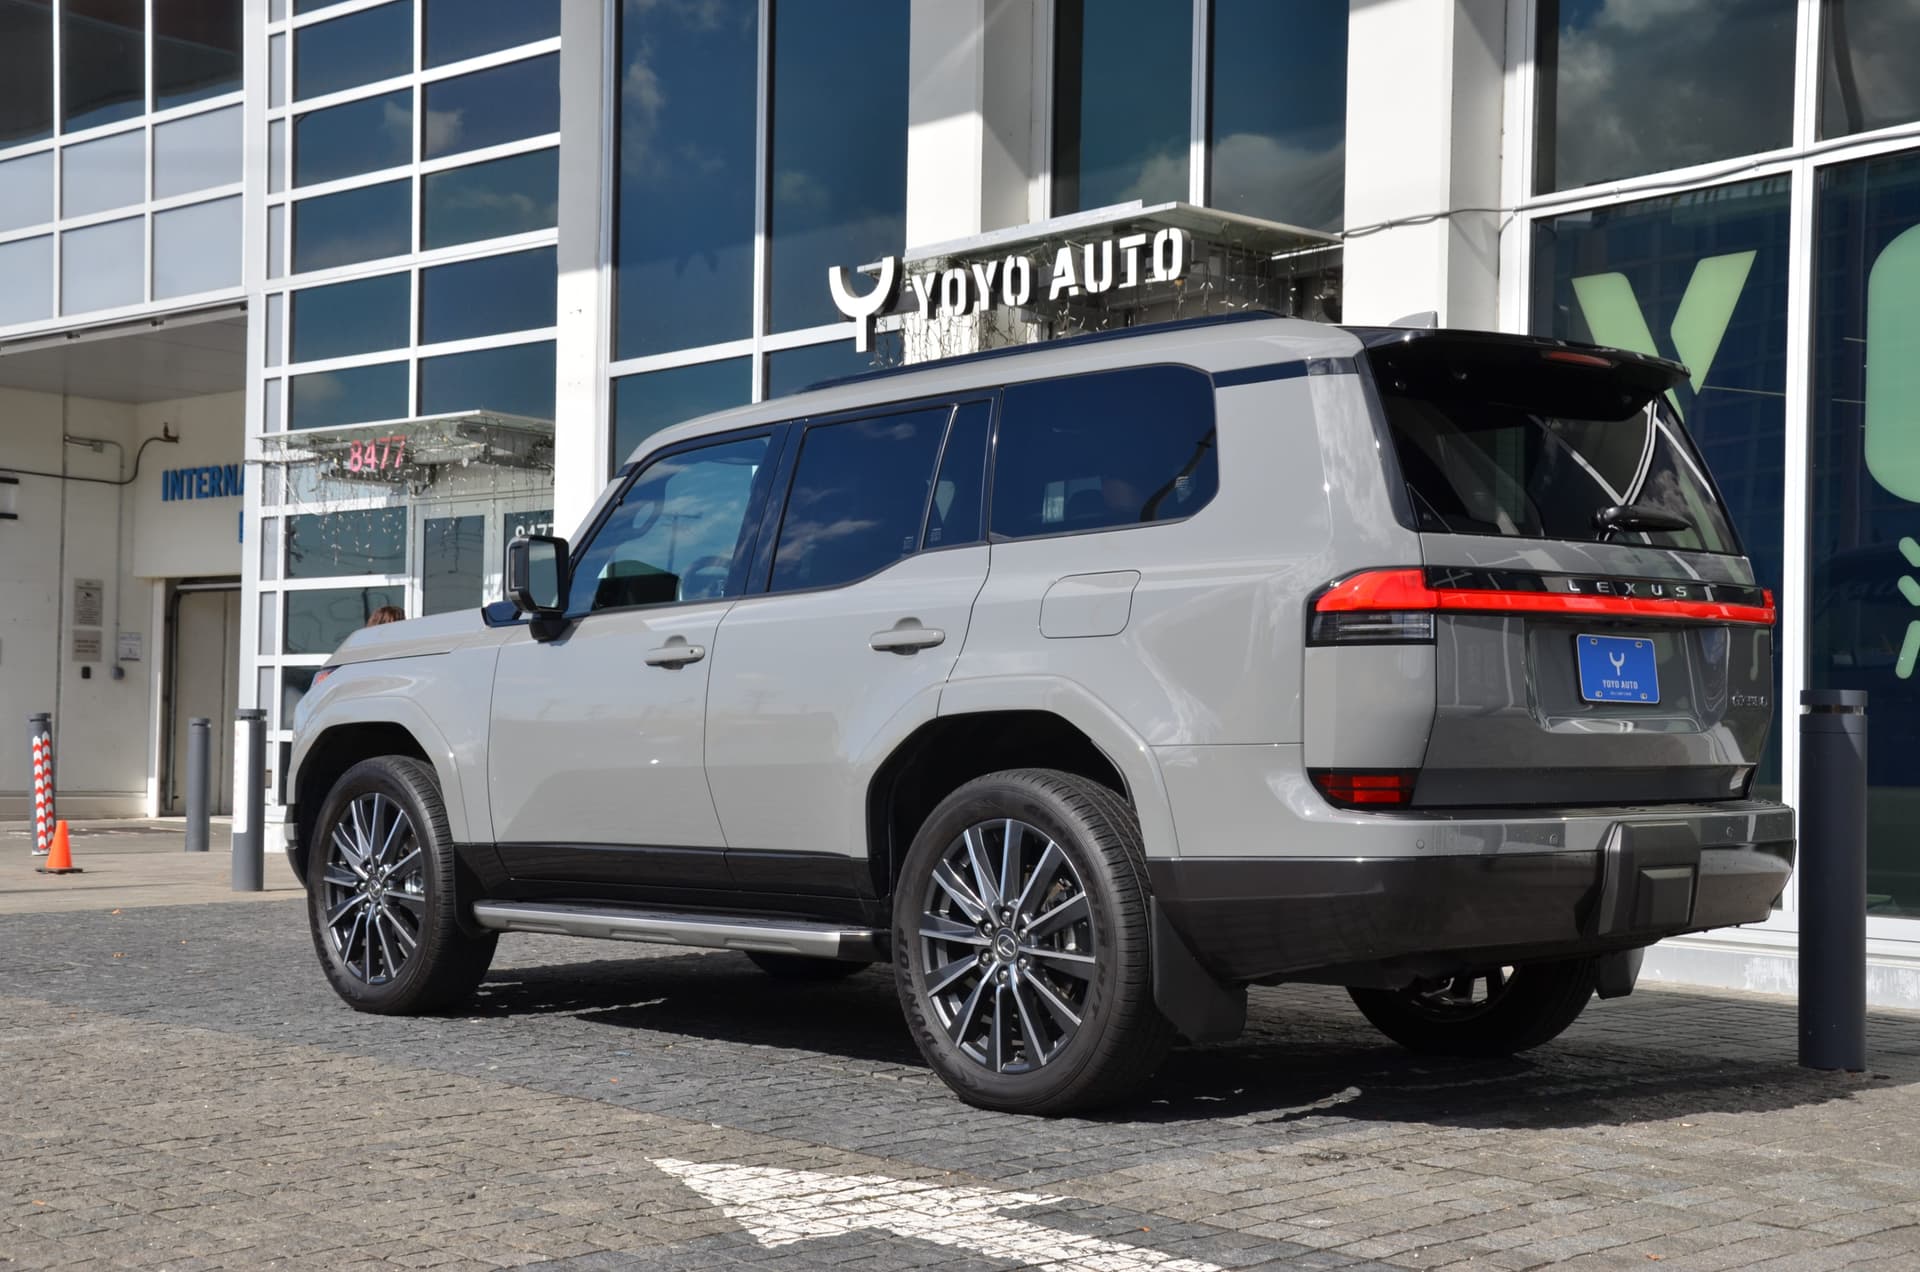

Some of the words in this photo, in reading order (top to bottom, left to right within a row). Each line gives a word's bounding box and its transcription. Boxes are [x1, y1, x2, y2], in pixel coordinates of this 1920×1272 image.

[911, 255, 1034, 320] YOYO
[1050, 227, 1186, 300] AUTO
[349, 434, 407, 473] 8477
[1567, 579, 1687, 597] LEXUS
[1602, 679, 1620, 689] YOYO
[1621, 680, 1639, 690] AUTO
[898, 928, 938, 1045] DUNLOP
